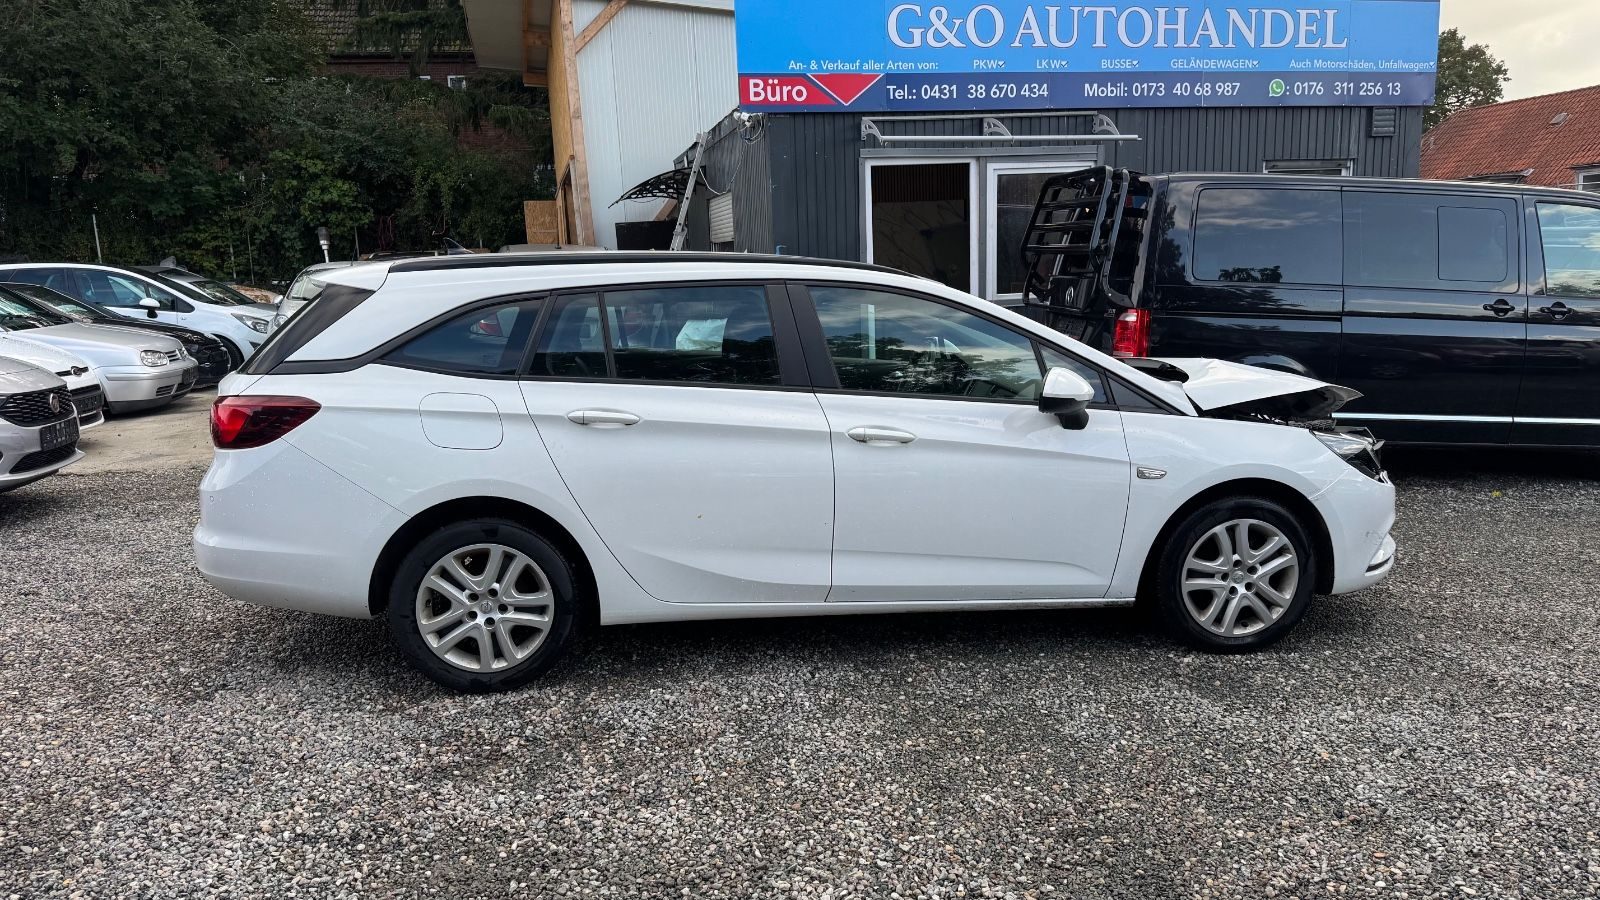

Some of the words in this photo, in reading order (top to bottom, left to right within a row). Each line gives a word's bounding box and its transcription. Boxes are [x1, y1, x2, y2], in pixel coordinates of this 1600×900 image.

[887, 4, 1005, 48] G&O
[1011, 6, 1348, 49] AUTOHANDEL
[788, 60, 806, 71] An-
[810, 60, 818, 71] &
[821, 59, 860, 71] Verkauf
[862, 60, 884, 71] aller
[886, 59, 915, 71] Arten
[917, 61, 939, 70] von:
[973, 59, 998, 69] PKW
[1101, 59, 1132, 69] BUSSE
[1170, 57, 1253, 69] GELÄNDEWAGEN
[1289, 60, 1311, 69] Auch
[1313, 59, 1376, 70] Motorschäden,
[1378, 59, 1430, 71] Unfallwagen
[748, 79, 808, 103] Büro
[886, 85, 917, 100] Tel.:
[921, 84, 957, 100] 0431
[967, 84, 986, 99] 38
[990, 84, 1017, 99] 670
[1020, 83, 1049, 98] 434
[1084, 82, 1129, 98] Mobil:
[1132, 82, 1165, 97] 0173
[1172, 82, 1191, 96] 40
[1194, 82, 1212, 96] 68
[1215, 82, 1241, 96] 987
[1293, 81, 1324, 96] 0176
[1333, 82, 1354, 96] 311
[1359, 82, 1383, 96] 256
[1387, 82, 1401, 96] 13
